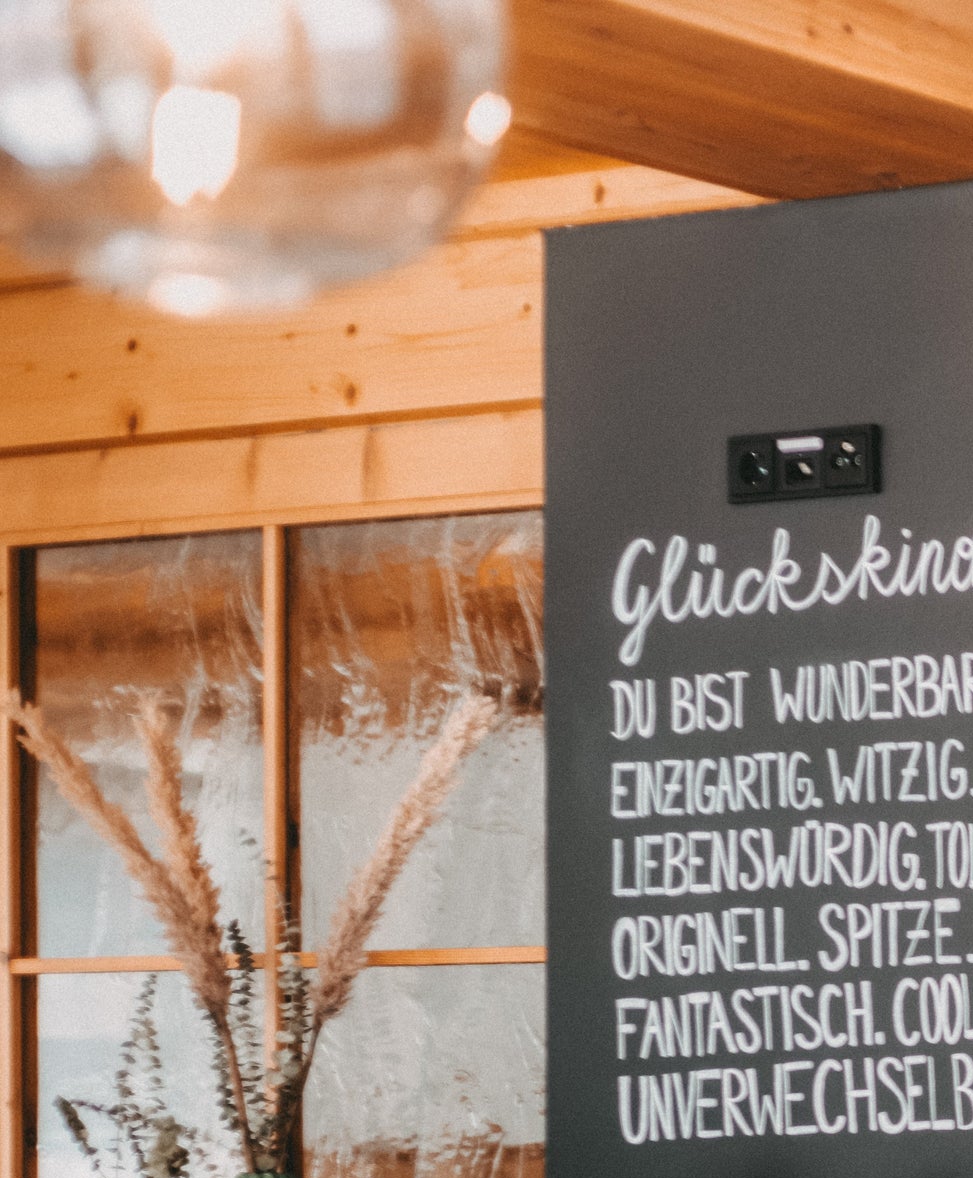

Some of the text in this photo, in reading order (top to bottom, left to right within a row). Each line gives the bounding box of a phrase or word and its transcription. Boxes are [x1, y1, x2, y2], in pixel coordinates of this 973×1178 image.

[610, 678, 657, 741] DU
[670, 670, 750, 734] BIST
[611, 751, 823, 819] EINZIGARTIG.
[612, 820, 926, 896] LEBENSWÜRDIG.
[611, 906, 810, 980] ORIGINELL.
[616, 980, 887, 1060] FANTASTISCH.
